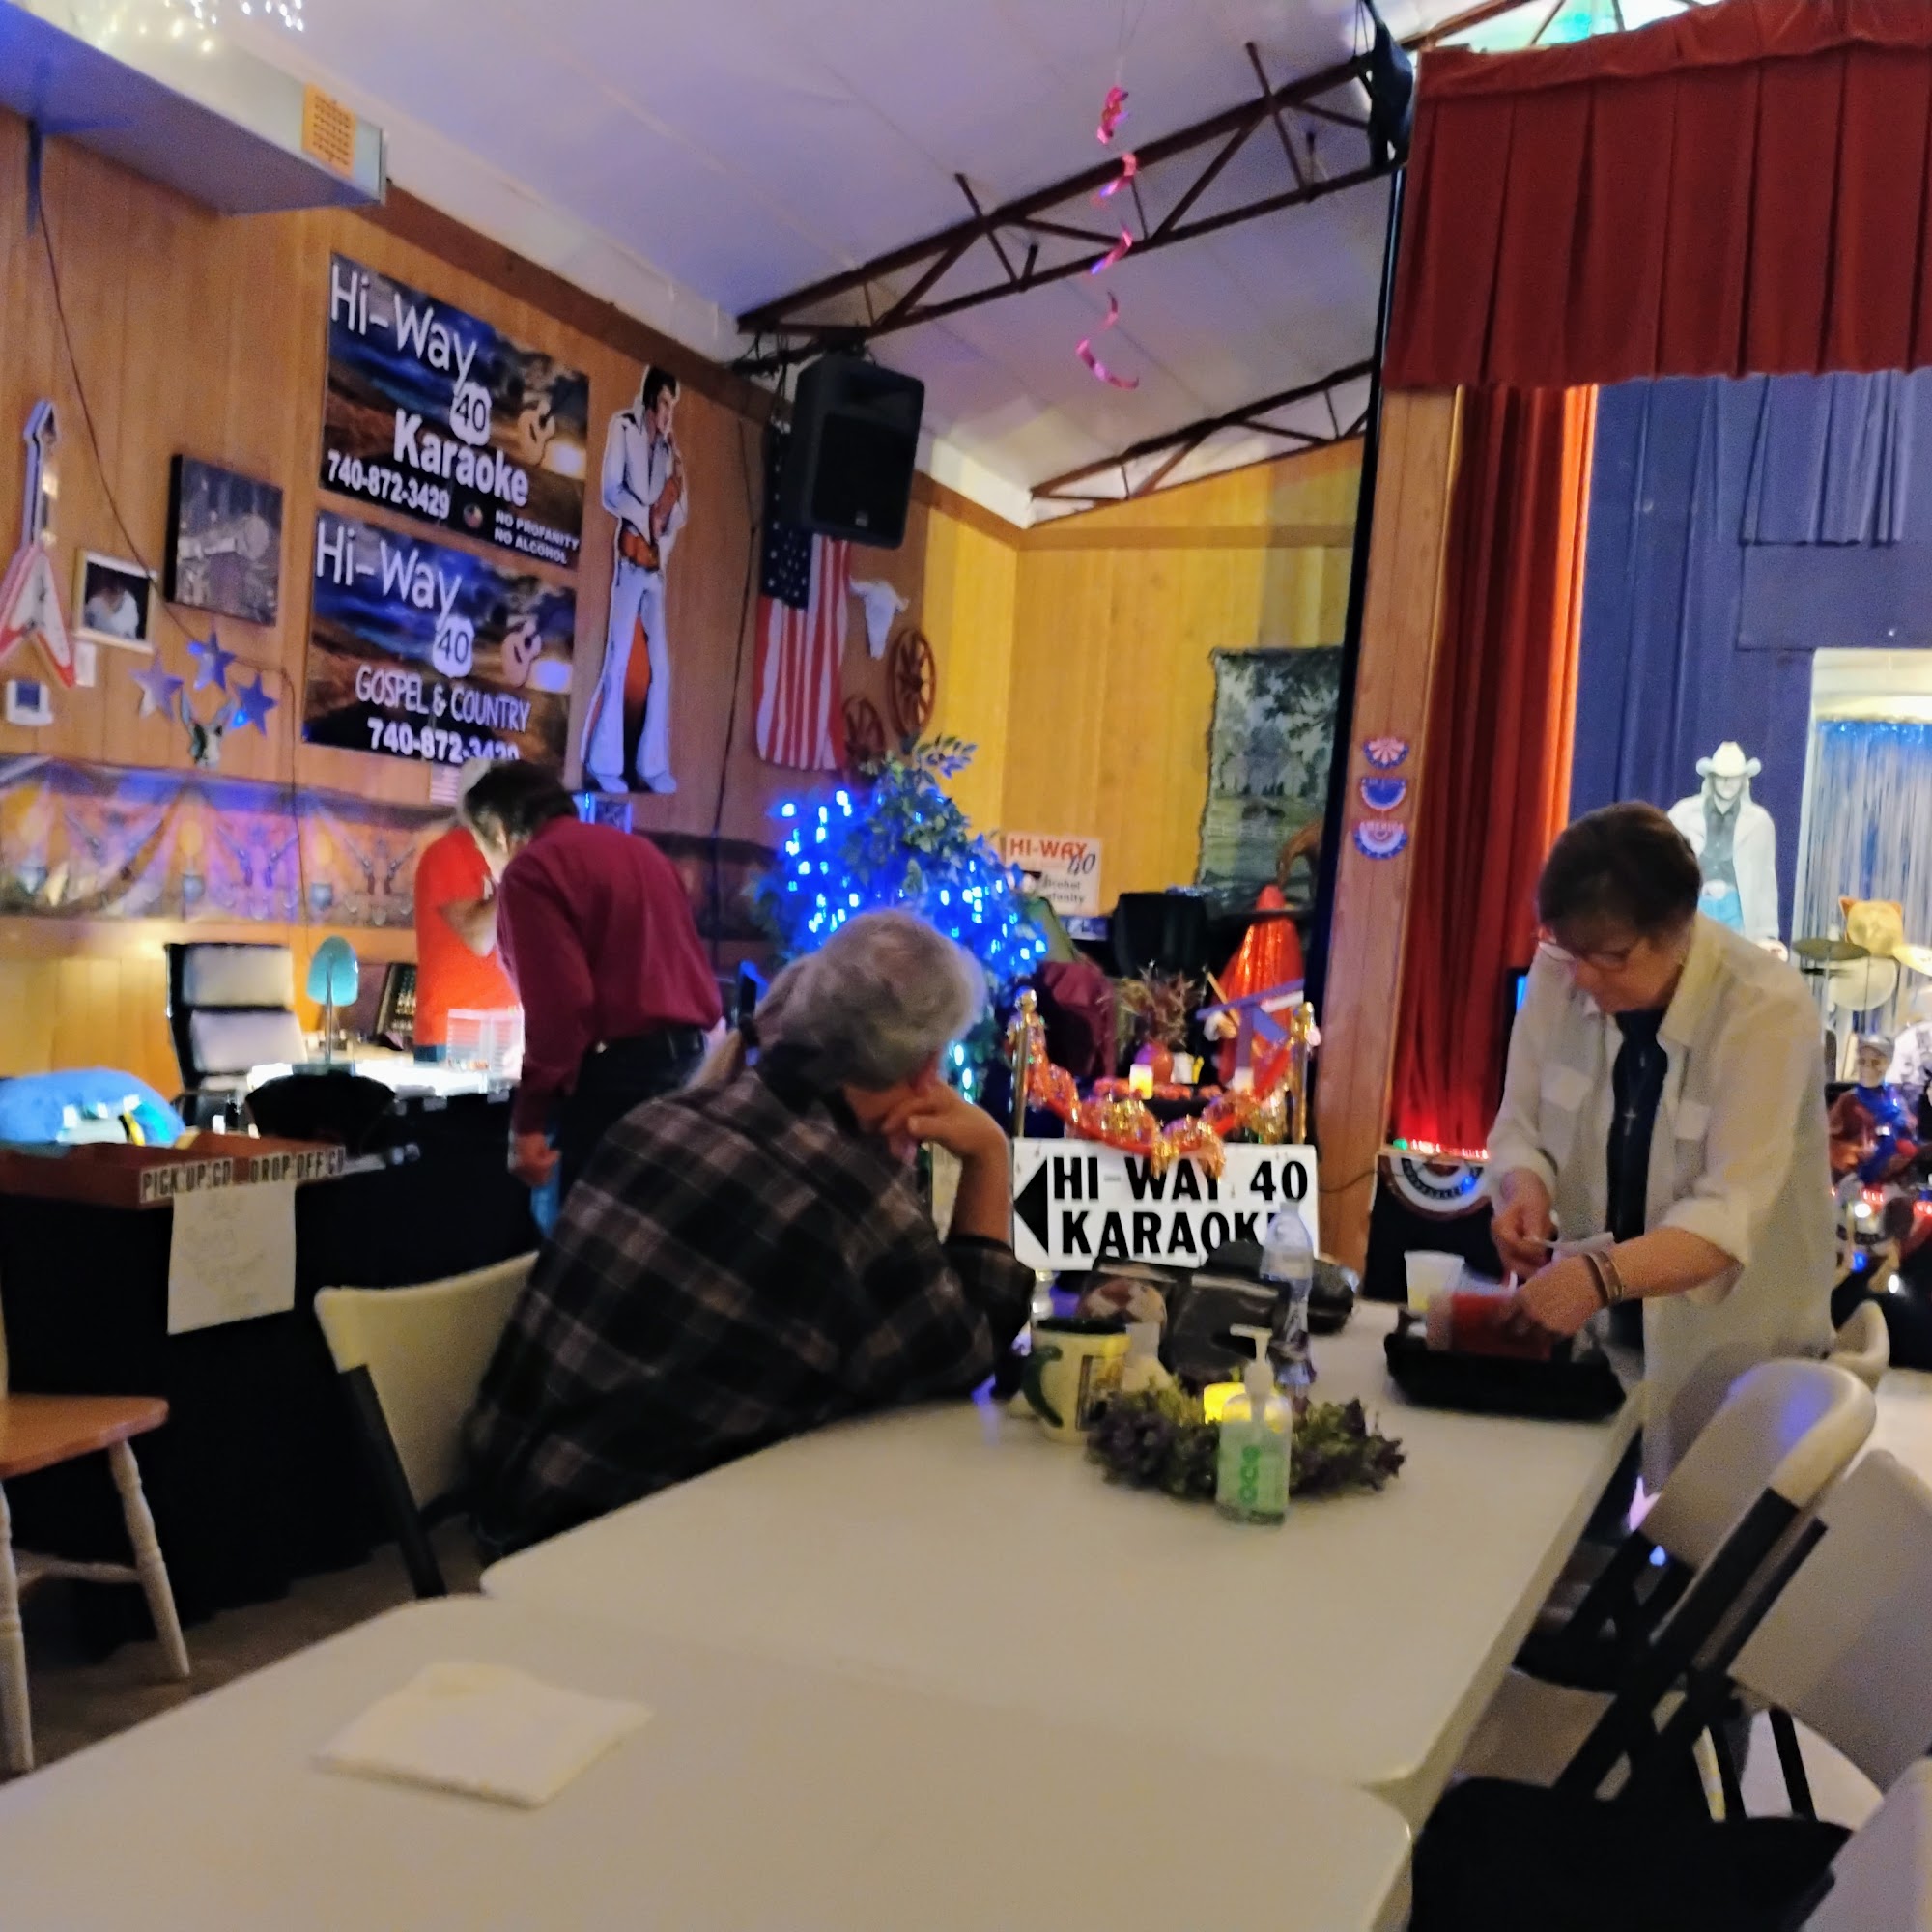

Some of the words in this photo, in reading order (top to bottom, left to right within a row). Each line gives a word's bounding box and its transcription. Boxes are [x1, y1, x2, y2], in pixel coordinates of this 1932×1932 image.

[330, 262, 477, 397] Hi-Way
[454, 393, 489, 433] 40
[393, 407, 529, 507] Karaoke
[327, 448, 451, 520] 740-872-3429
[494, 527, 513, 545] NO
[515, 535, 567, 565] ALCOHOL
[495, 509, 514, 527] NO
[515, 517, 580, 551] PROFANITY
[316, 518, 462, 635] Hi-Way
[438, 628, 469, 665] 40
[355, 665, 430, 715] GOSPEL
[433, 684, 447, 717] &
[450, 685, 531, 733] COUNTRY
[143, 1168, 181, 1197] PICK
[185, 1163, 206, 1192] UP
[249, 1154, 290, 1184] DROP
[297, 1151, 324, 1180] OFF
[1250, 1160, 1309, 1202] 40
[1062, 1210, 1277, 1259] KARAOK
